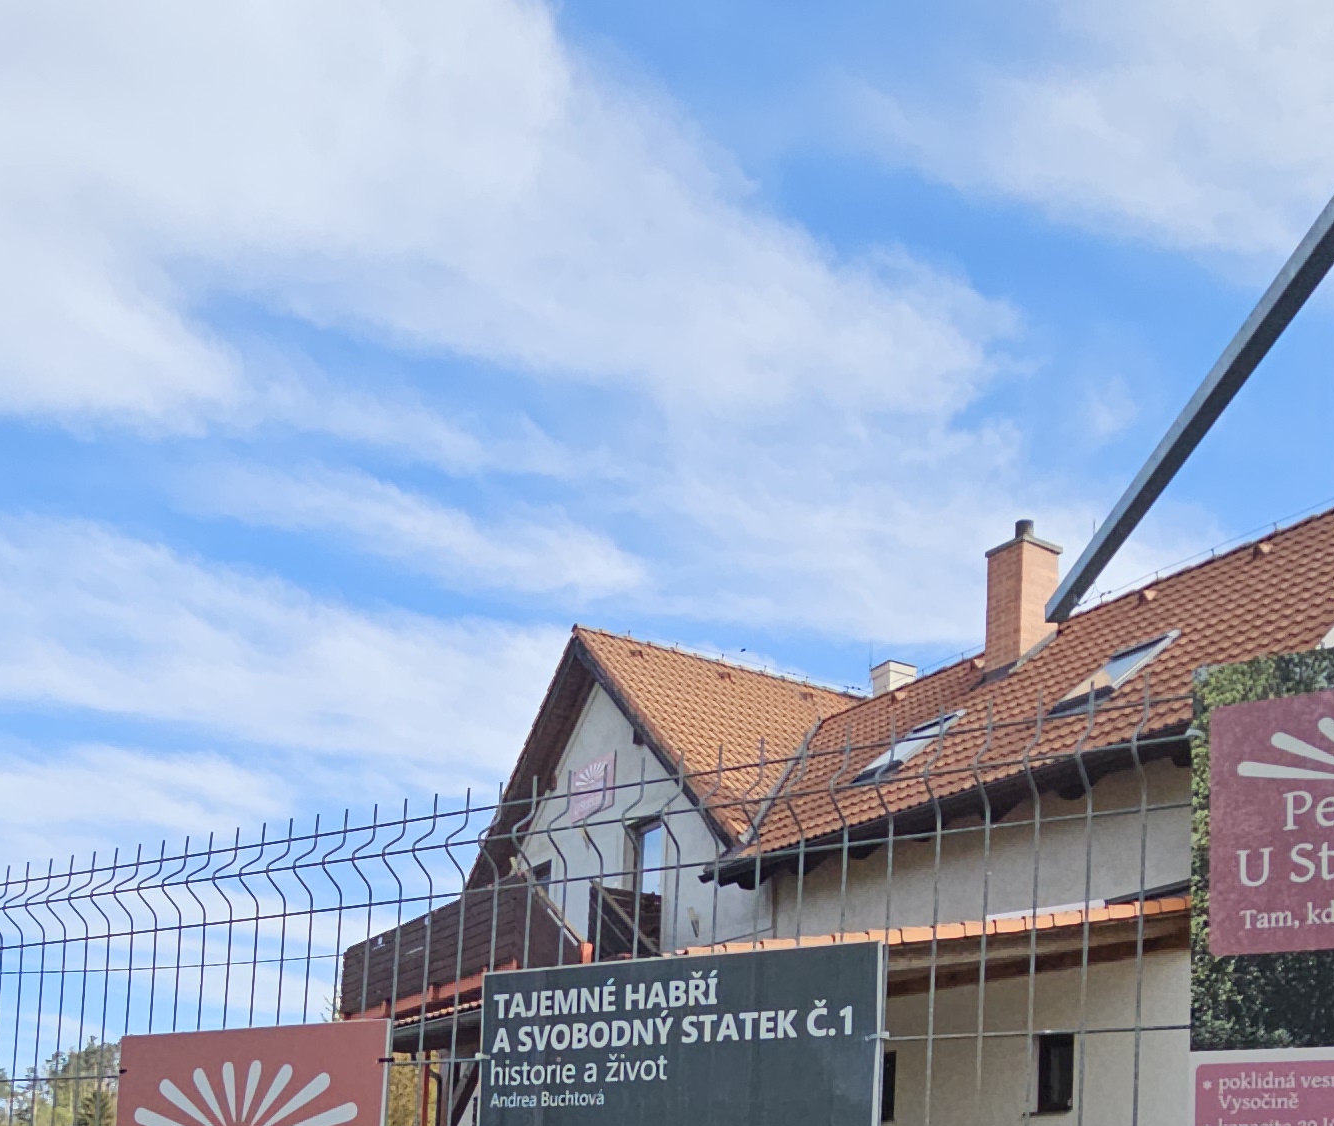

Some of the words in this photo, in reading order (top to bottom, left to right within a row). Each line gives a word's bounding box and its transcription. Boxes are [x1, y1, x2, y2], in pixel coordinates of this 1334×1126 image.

[1236, 848, 1273, 887] U
[1240, 910, 1299, 929] Tam,
[494, 979, 616, 1019] TAJEMNÉ
[625, 970, 718, 1010] HABŘÍ
[492, 1028, 510, 1053] A
[517, 1011, 672, 1052] SVOBODNÝ
[681, 1010, 798, 1044] STATEK
[489, 1057, 576, 1086] historie
[584, 1063, 596, 1082] a
[605, 1054, 667, 1082] život
[1219, 1071, 1296, 1094] poklidná
[490, 1092, 537, 1108] Andrea
[541, 1088, 604, 1106] Buchtová
[1219, 1092, 1299, 1113] Vysočině
